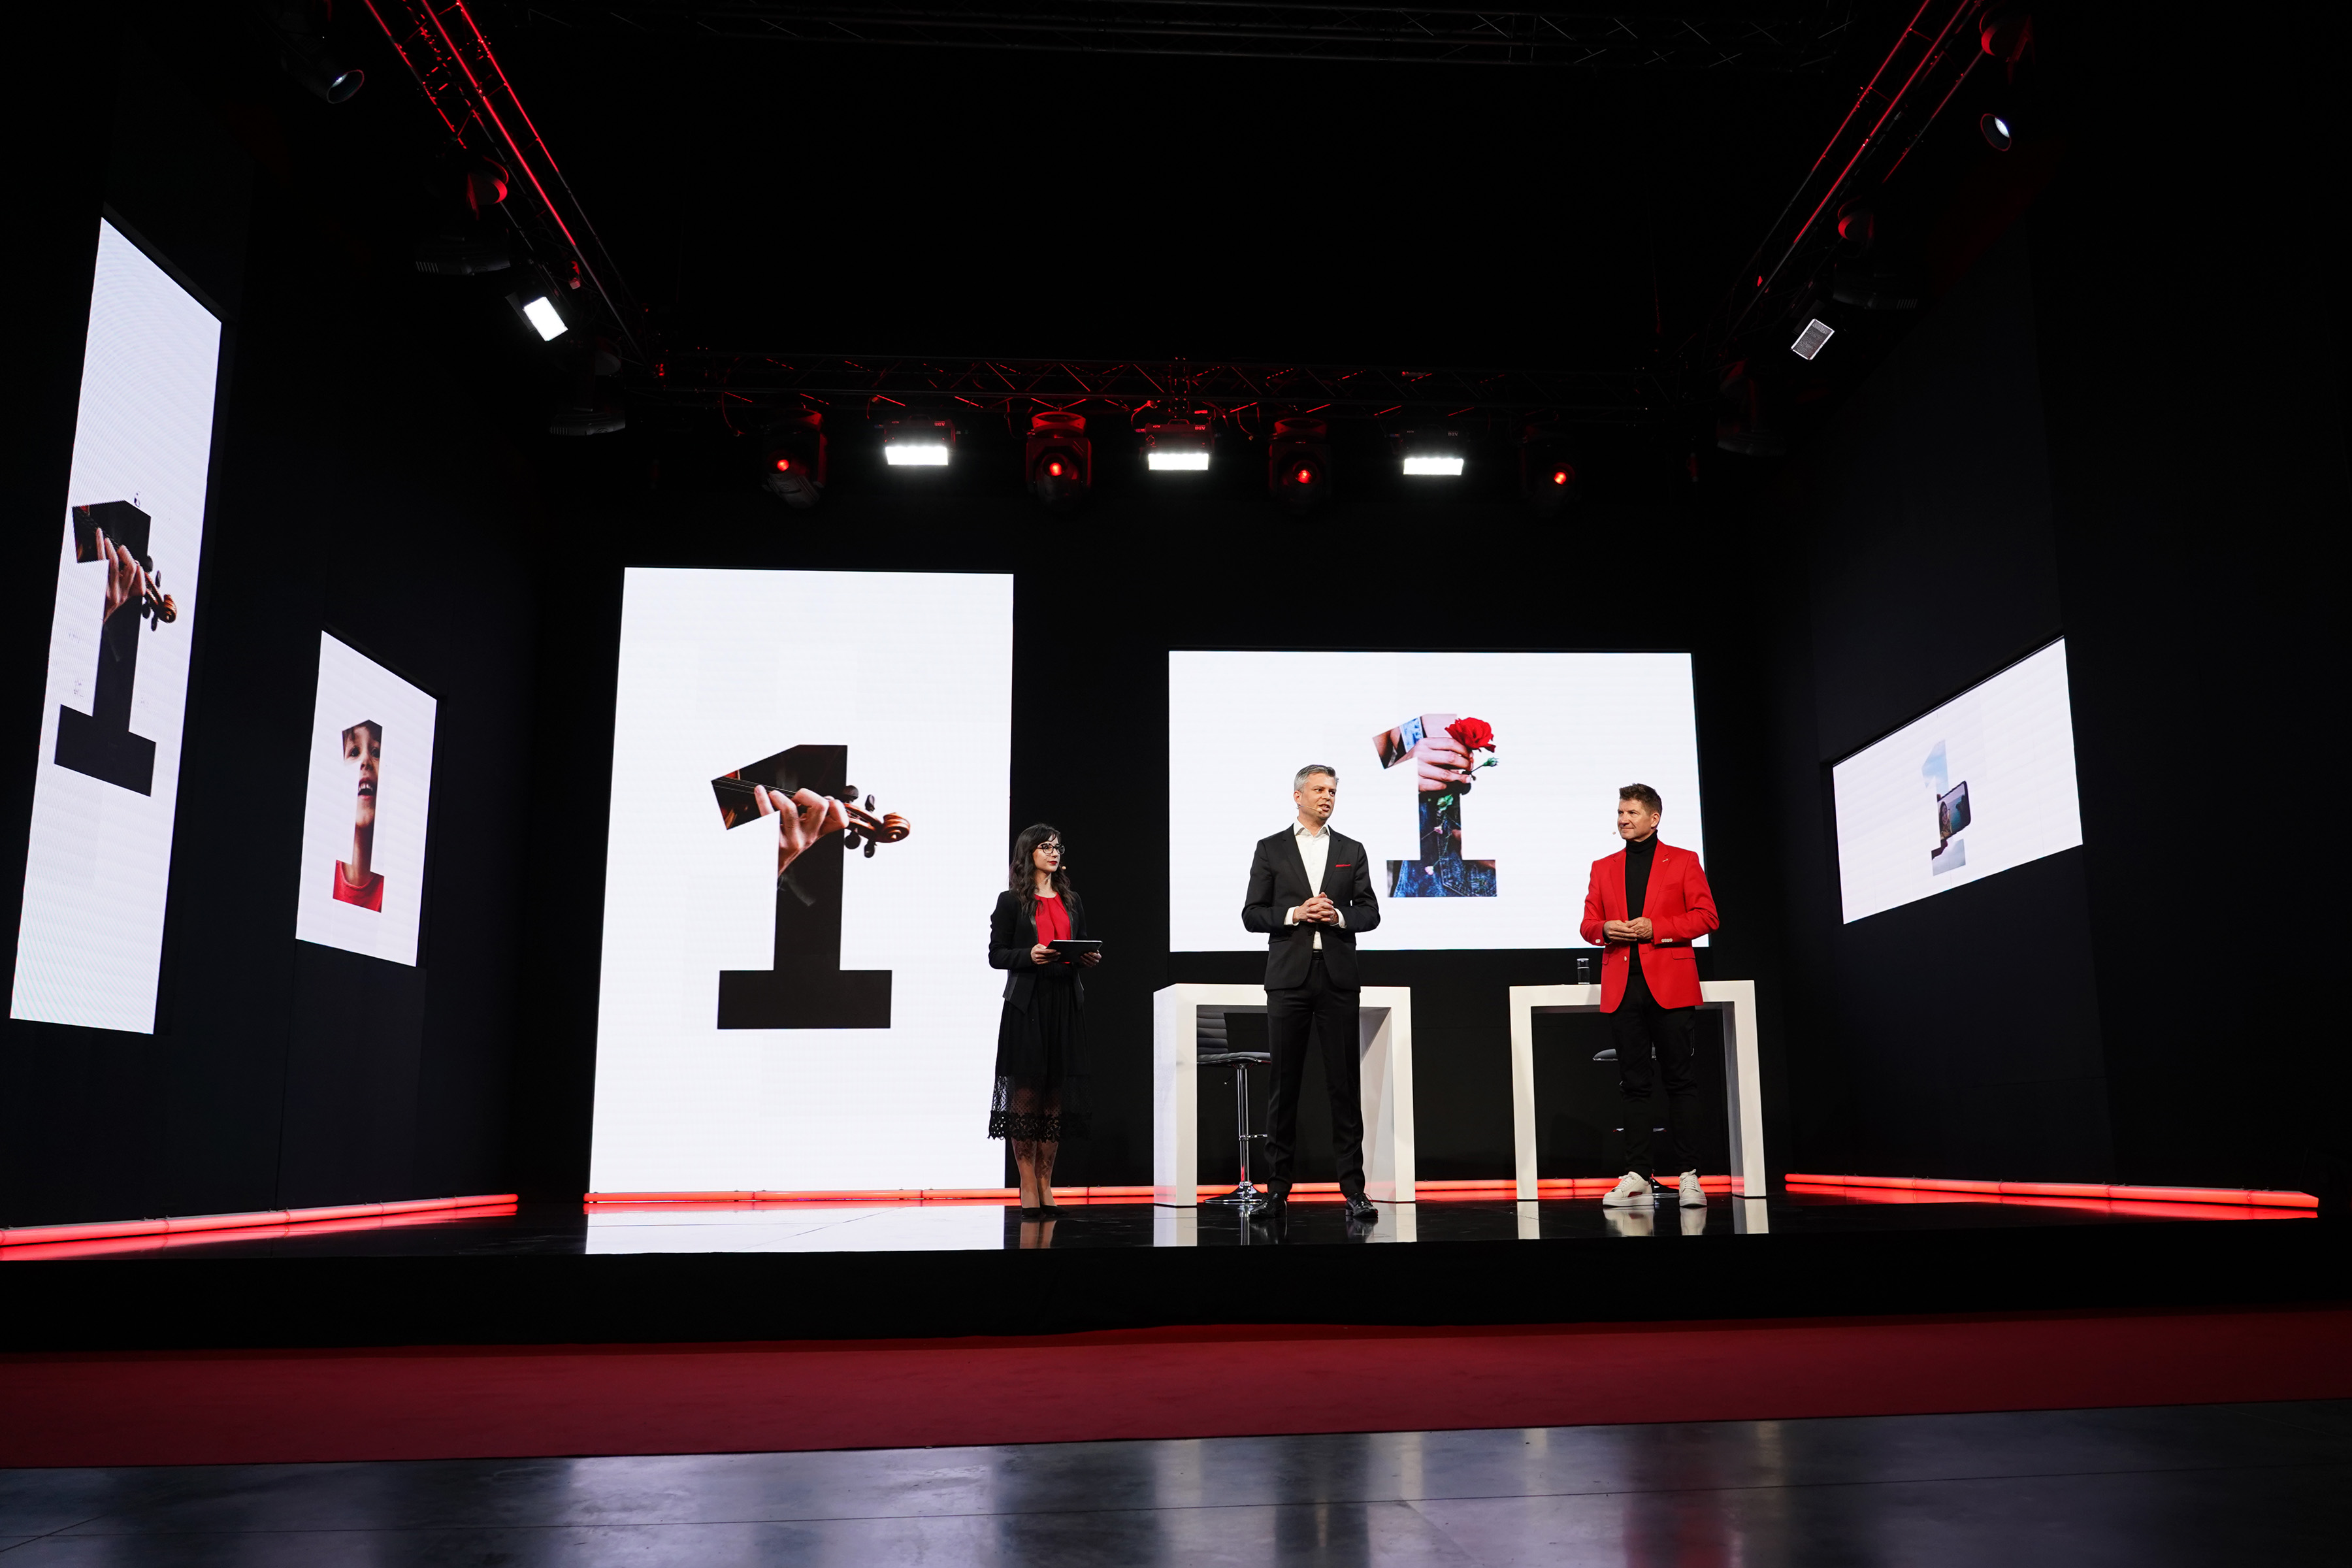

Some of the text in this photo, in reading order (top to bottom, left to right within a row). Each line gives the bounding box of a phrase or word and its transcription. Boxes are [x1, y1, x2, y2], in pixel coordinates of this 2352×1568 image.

[54, 500, 157, 798] 1
[333, 719, 385, 913] 1
[711, 744, 892, 1030] 1
[1373, 713, 1497, 898] 1
[1921, 740, 1967, 877] 1
